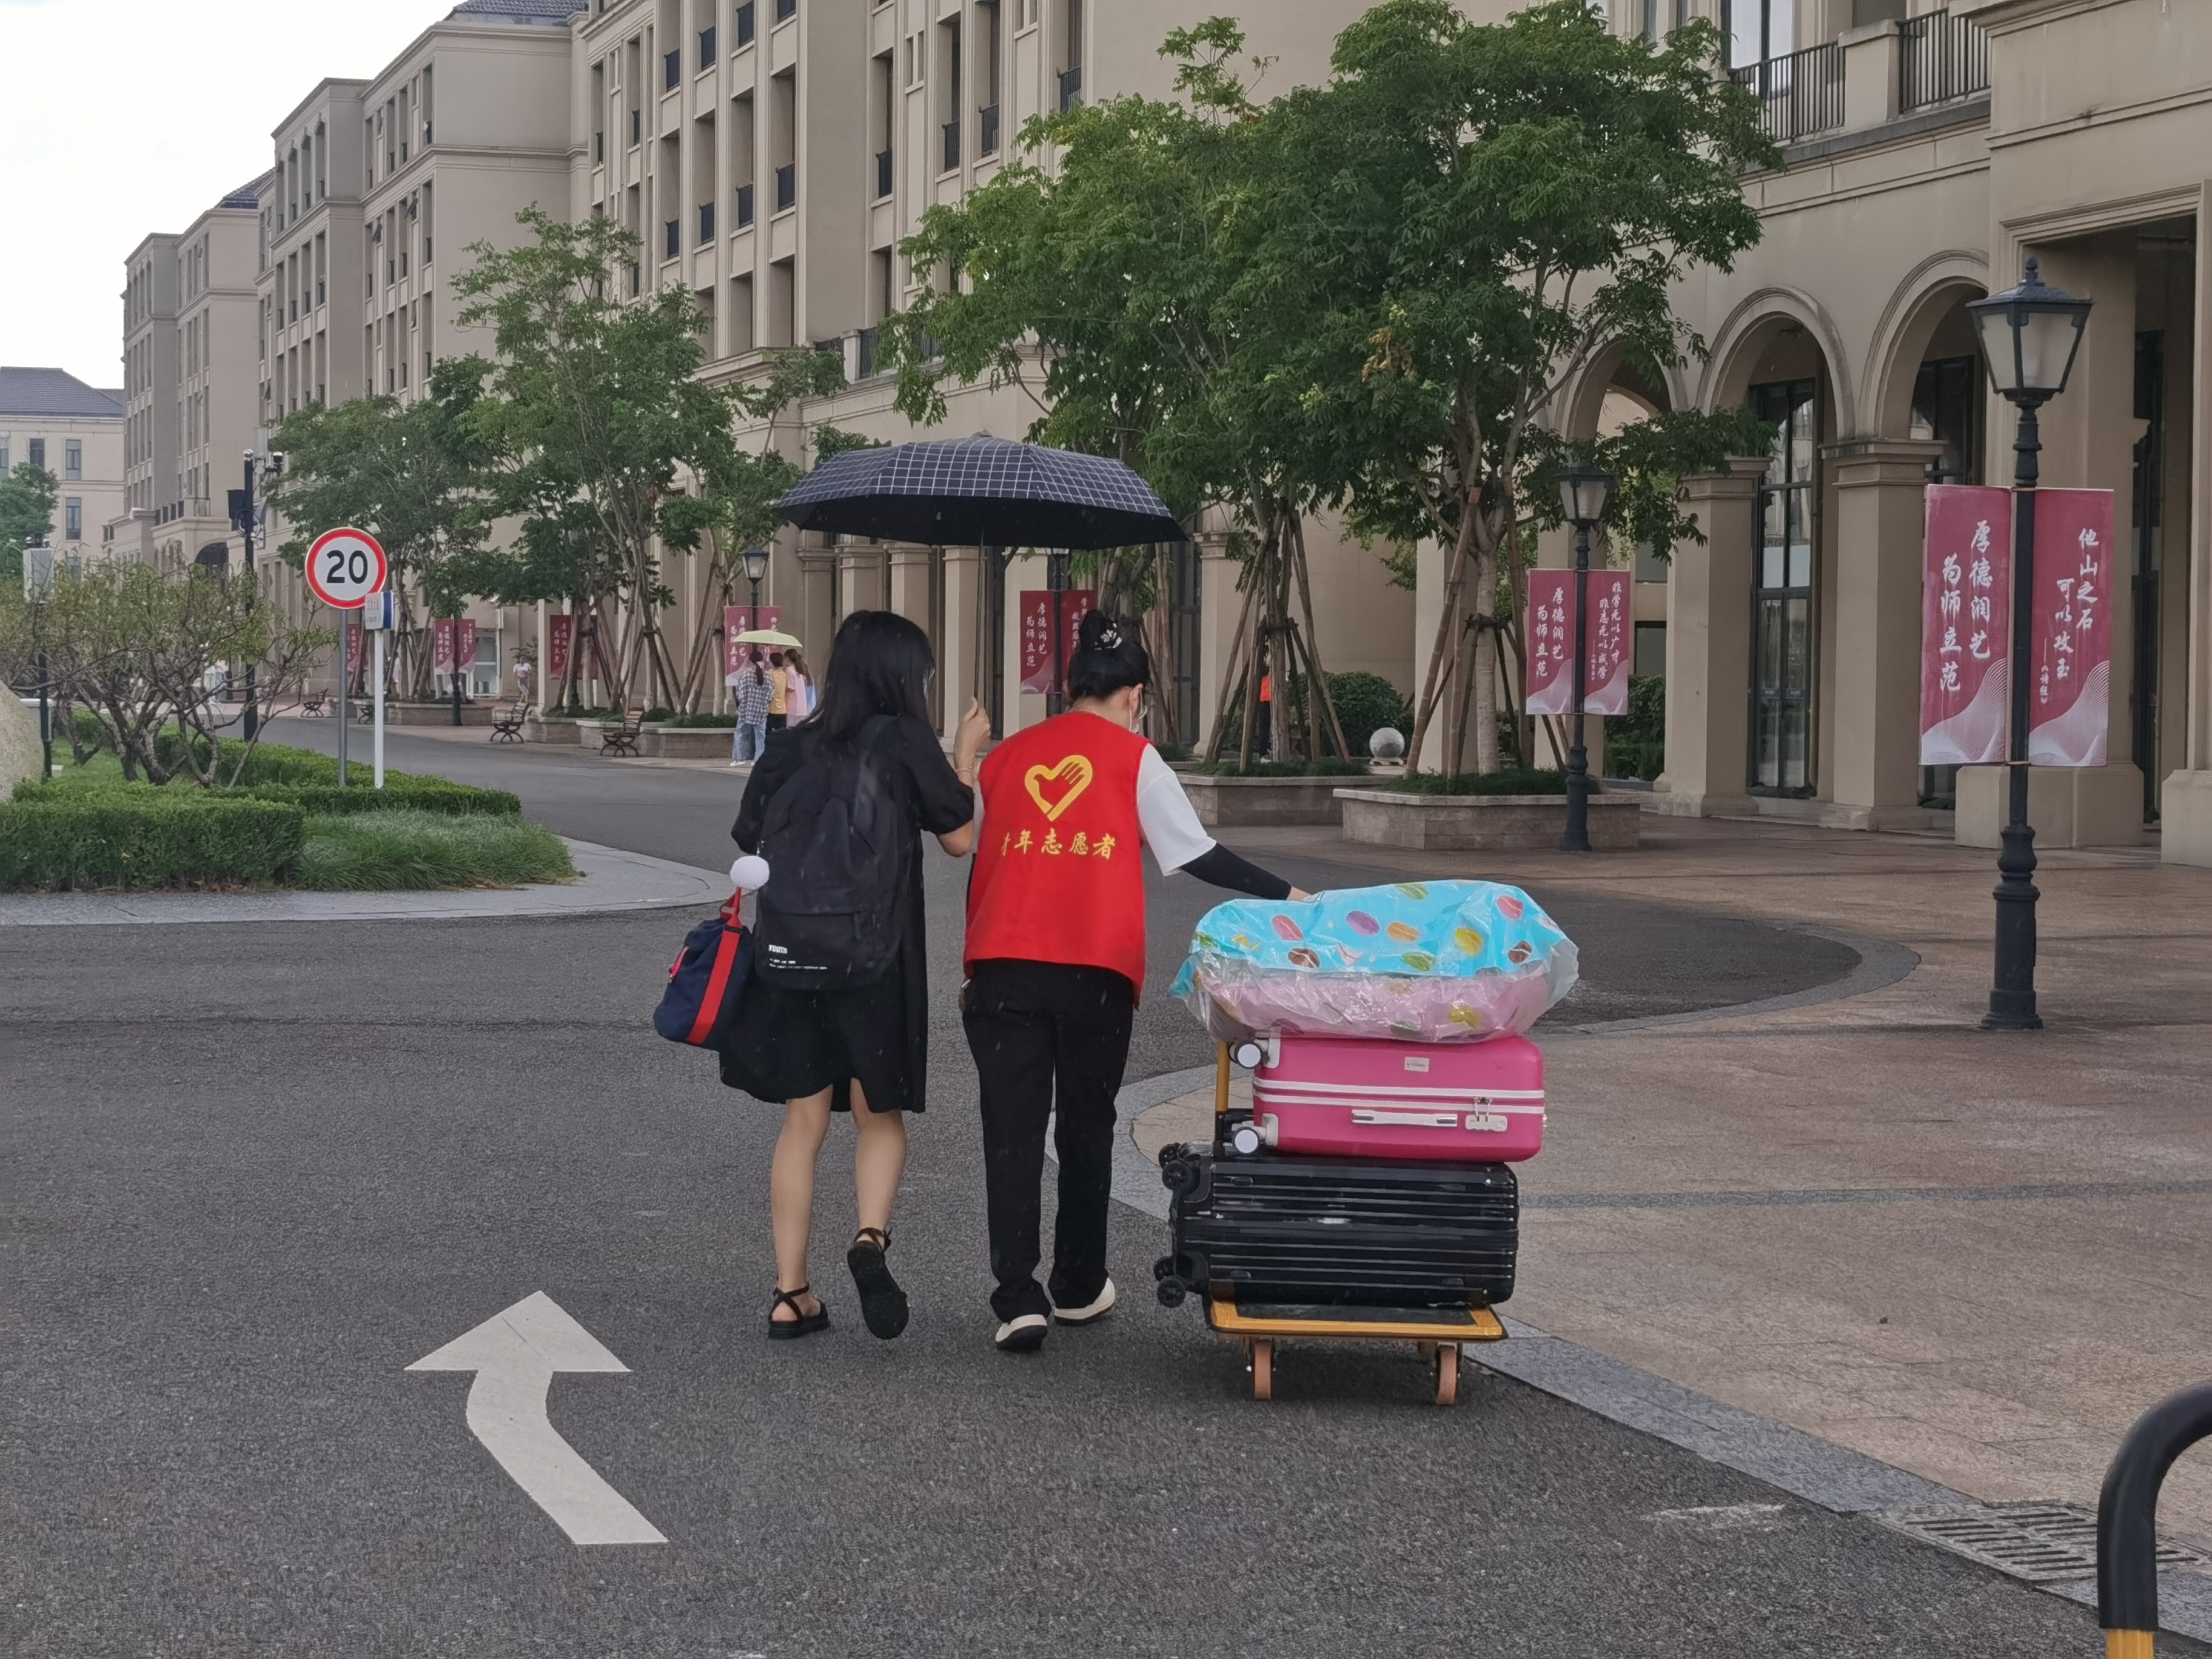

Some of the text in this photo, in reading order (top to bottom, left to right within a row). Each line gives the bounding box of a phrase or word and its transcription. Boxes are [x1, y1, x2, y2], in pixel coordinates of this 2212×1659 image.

[326, 549, 368, 584] 20
[1969, 520, 1992, 659] 厚德润艺
[2076, 528, 2099, 629] 他山之石
[1536, 605, 1548, 677] 为师立范
[1552, 586, 1565, 659] 厚德润艺
[1609, 581, 1622, 665] 非学无以广才
[1940, 552, 1962, 692] 为师立范
[2053, 578, 2075, 679] 可以攻玉
